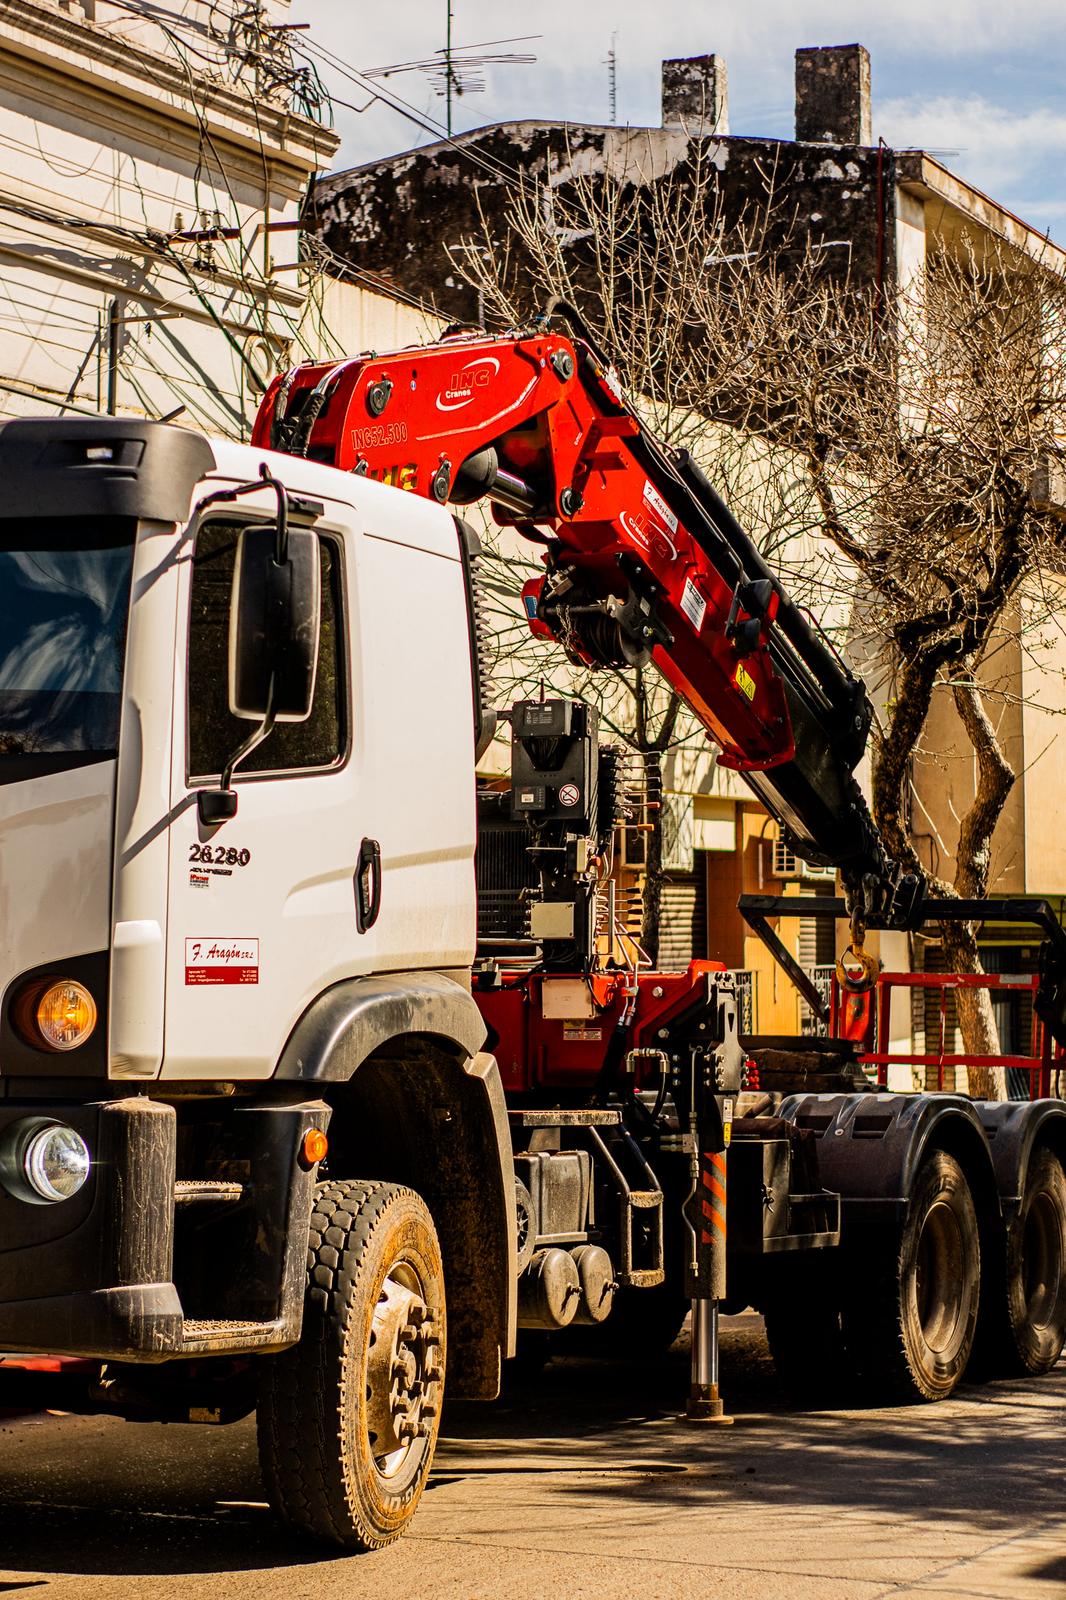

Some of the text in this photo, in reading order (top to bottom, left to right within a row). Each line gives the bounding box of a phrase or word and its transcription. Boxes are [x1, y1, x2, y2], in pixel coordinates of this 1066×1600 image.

[451, 370, 489, 390] ING
[445, 389, 471, 399] Cranes
[628, 517, 649, 545] Cranes
[188, 844, 250, 867] 26.280
[206, 943, 241, 963] Aragón
